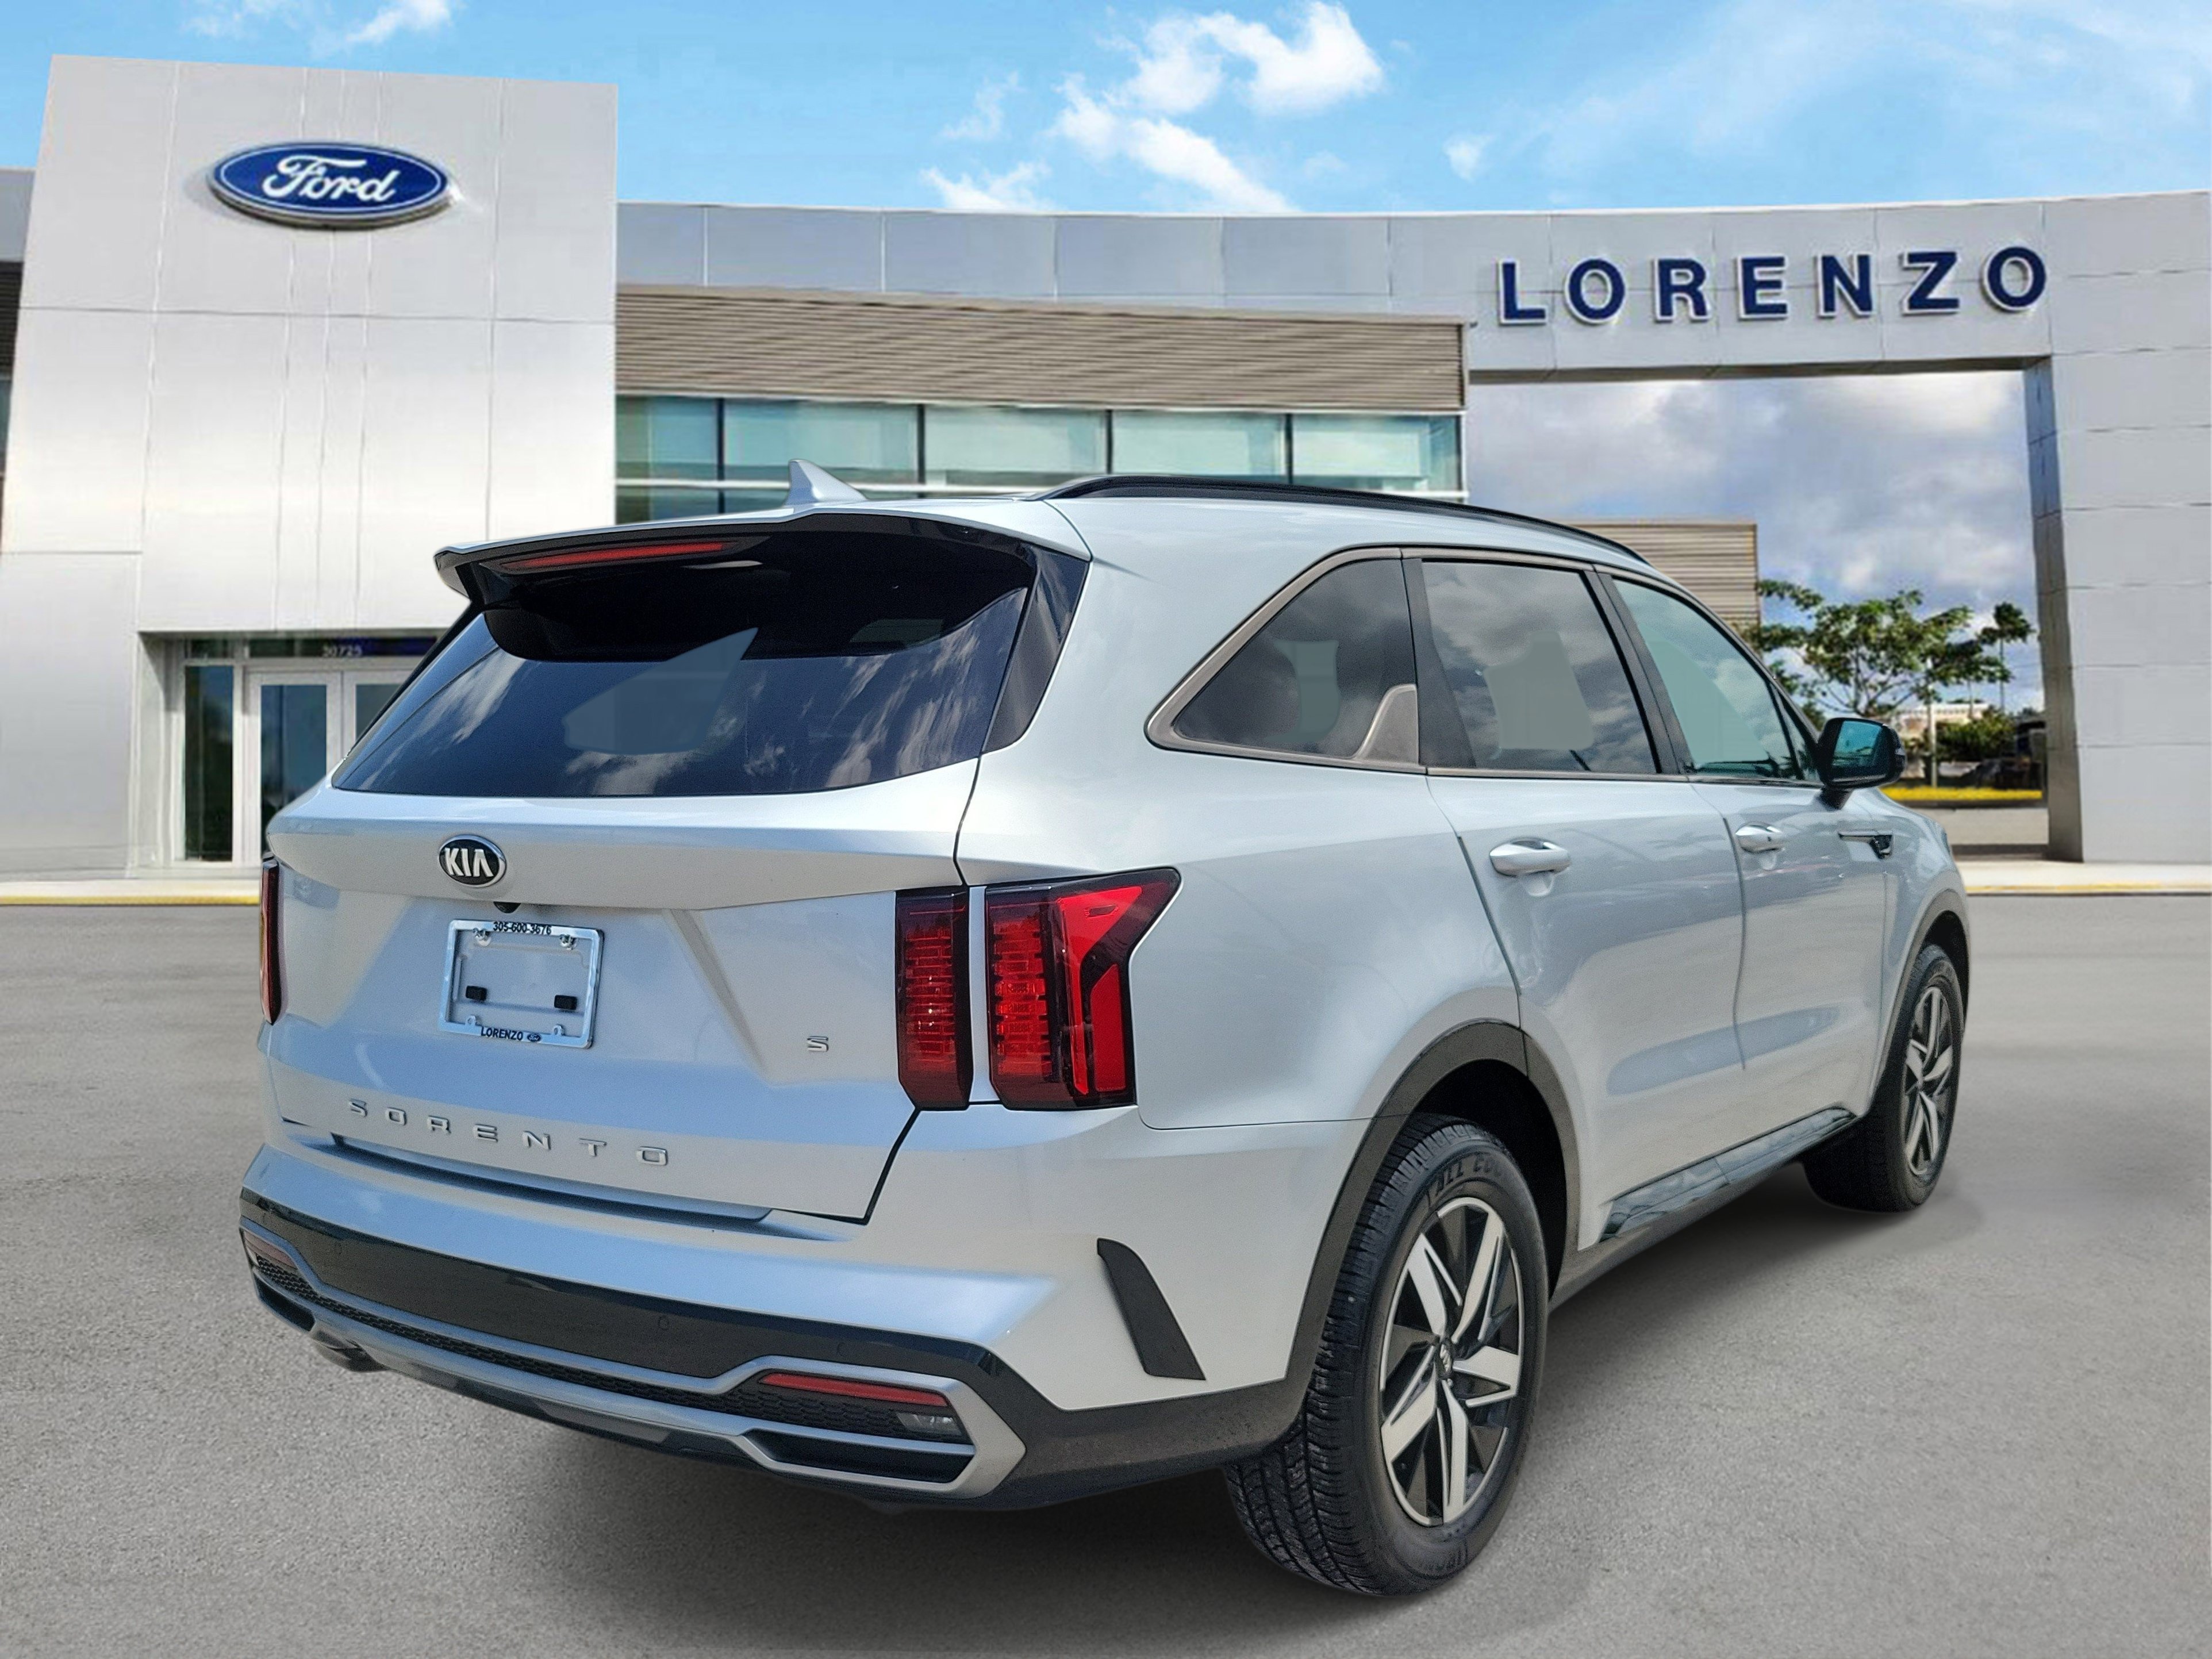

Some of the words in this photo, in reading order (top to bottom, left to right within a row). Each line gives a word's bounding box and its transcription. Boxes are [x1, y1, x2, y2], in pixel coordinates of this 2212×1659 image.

[262, 154, 401, 201] Ford
[1497, 246, 2047, 325] LORENZO
[444, 847, 494, 878] KIA
[493, 921, 551, 935] 305-600-3676
[481, 1026, 523, 1041] LORENZO
[807, 1036, 828, 1052] S
[348, 1098, 669, 1166] SORENTO
